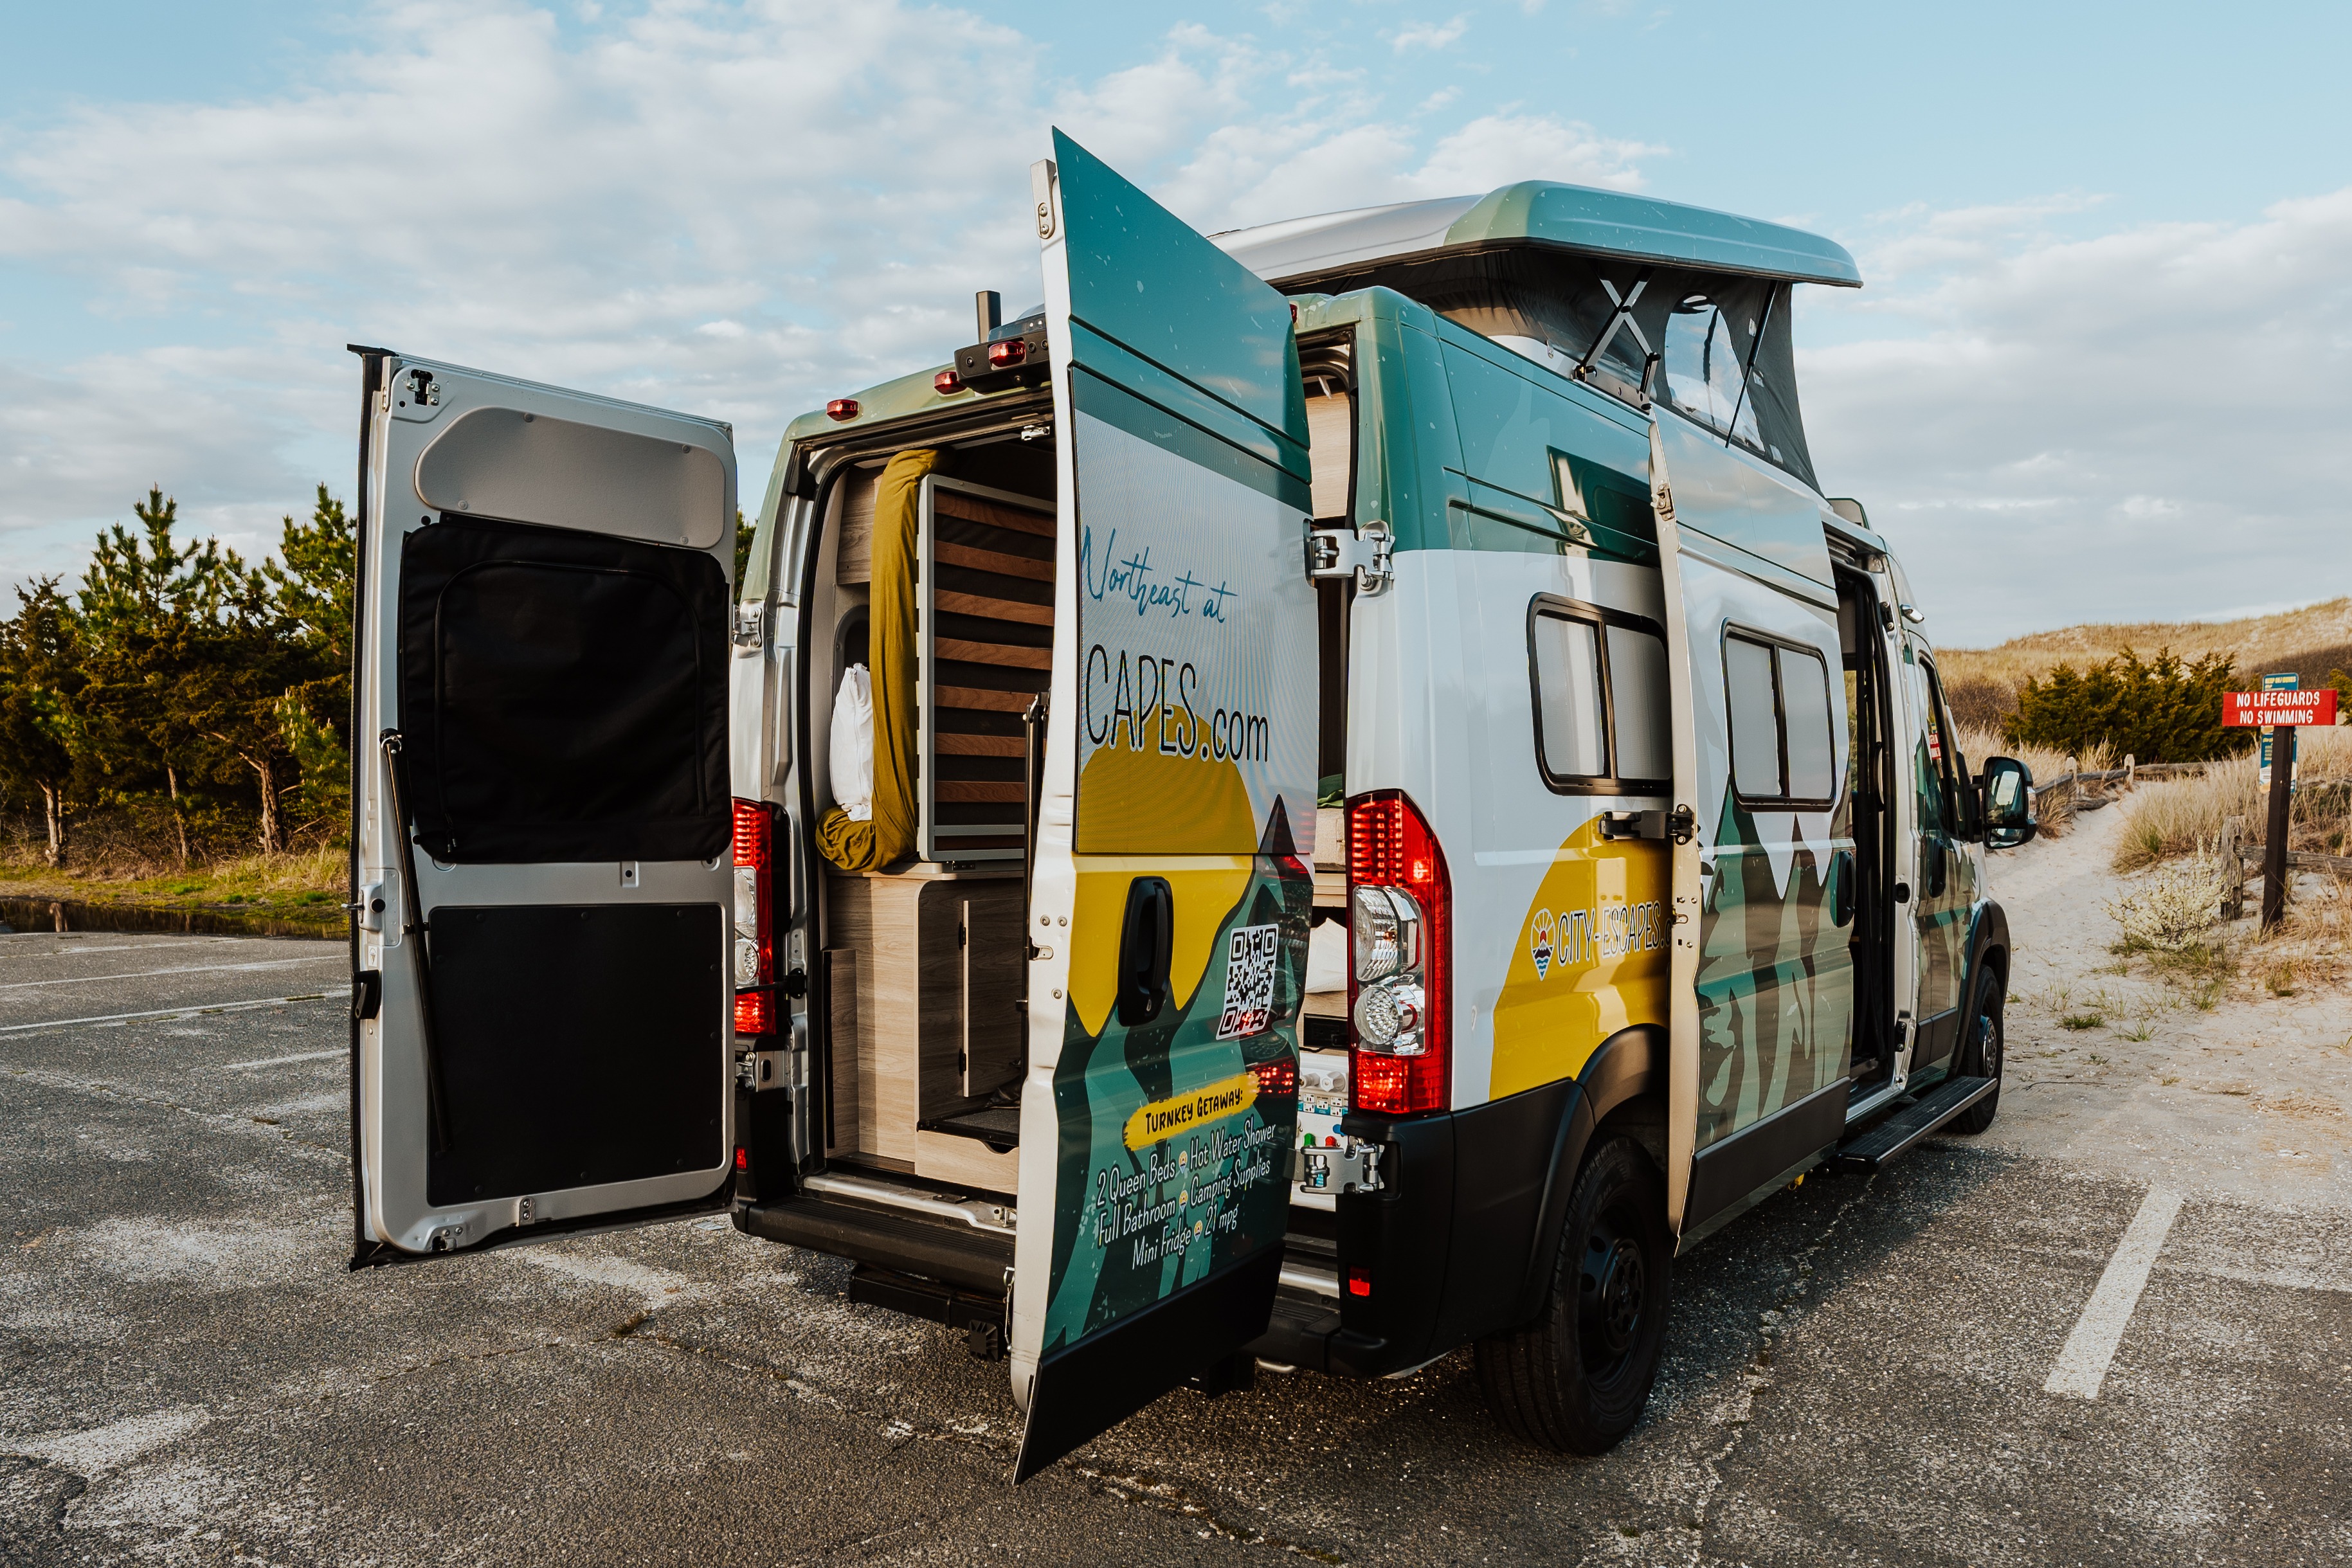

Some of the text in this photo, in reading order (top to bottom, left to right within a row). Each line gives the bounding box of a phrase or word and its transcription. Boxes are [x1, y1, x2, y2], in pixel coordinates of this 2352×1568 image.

[1081, 525, 1238, 623] Northeast at
[1085, 644, 1269, 762] CAPES.com
[2236, 691, 2320, 707] NO LIFEGUARDS
[2239, 709, 2313, 724] NO SWIMMING
[1145, 1088, 1243, 1135] TURNKEY GETAWAY:
[1097, 1116, 1276, 1206] 2 Queen Beds Hot Water Shower
[1099, 1149, 1271, 1246] Full Bathroom Camping Supplies
[1132, 1203, 1239, 1270] Mini Fridge 21 mpg
